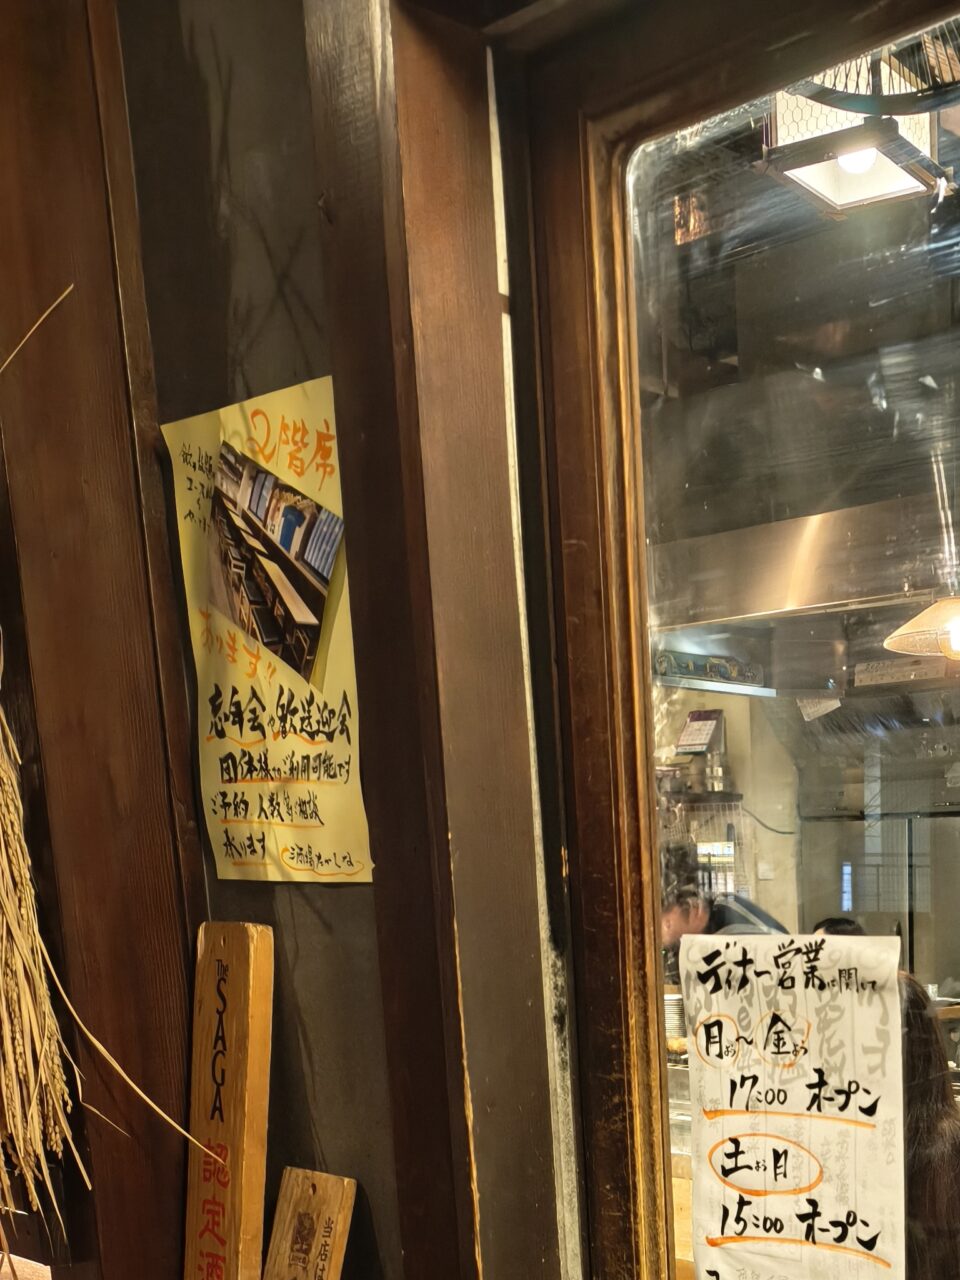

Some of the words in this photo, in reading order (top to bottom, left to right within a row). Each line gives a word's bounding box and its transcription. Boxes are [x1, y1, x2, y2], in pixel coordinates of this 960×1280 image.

[216, 959, 229, 977] The
[210, 977, 228, 1123] SAGA
[729, 1074, 788, 1111] 17:00
[805, 1067, 881, 1117] オープン
[720, 1193, 785, 1237] 15:00
[795, 1197, 882, 1251] オープン
